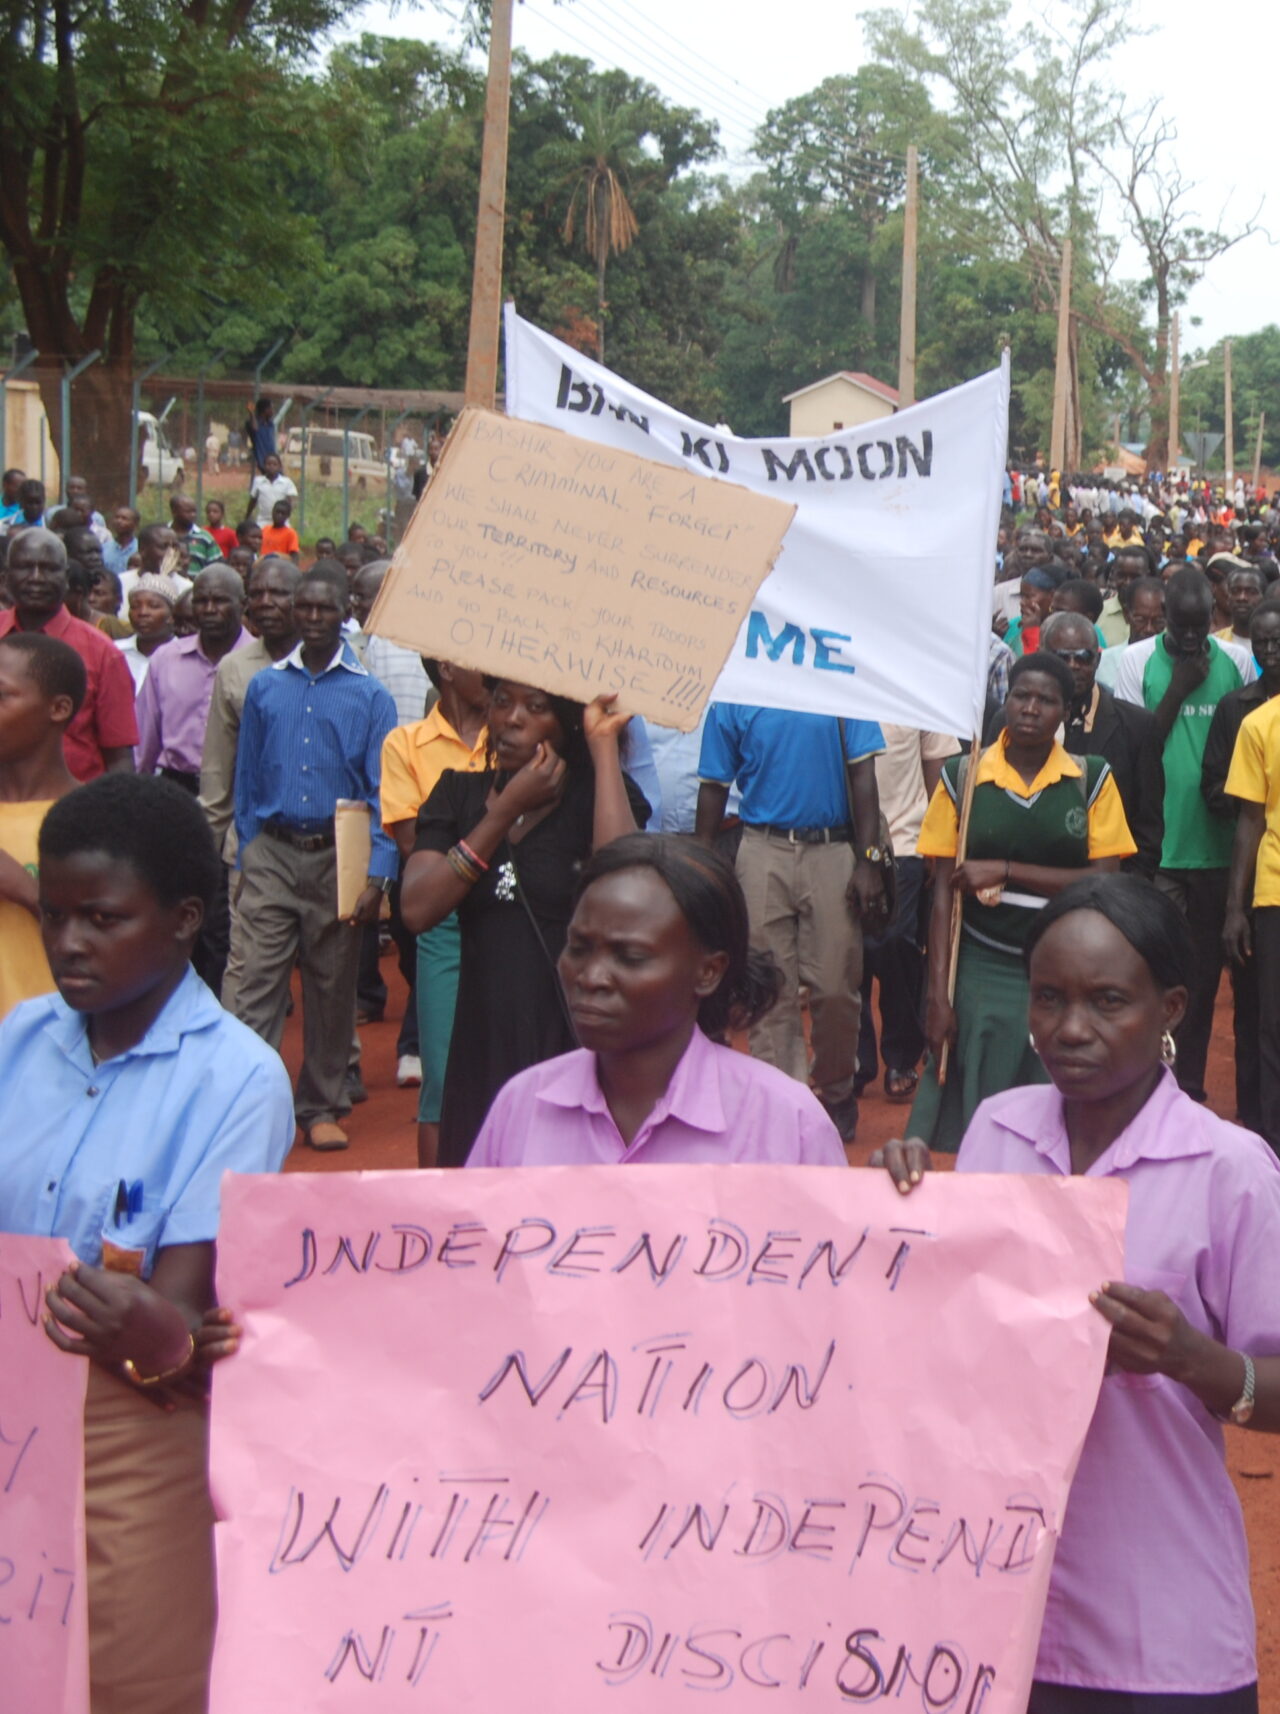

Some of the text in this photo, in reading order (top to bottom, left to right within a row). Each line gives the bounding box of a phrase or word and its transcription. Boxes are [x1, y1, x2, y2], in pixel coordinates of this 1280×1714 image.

[575, 446, 617, 473] YOU
[630, 467, 665, 493] ARE
[679, 485, 696, 506] A
[761, 430, 933, 482] MOON
[445, 482, 477, 501] WE
[553, 518, 625, 555] NEVER
[432, 508, 739, 615] OUR TERRITORY AND RESOURCES
[407, 584, 444, 604] AND
[496, 607, 549, 634] BACK
[596, 634, 704, 681] KHARTOUM
[430, 558, 706, 650] PLEASE PACK YOUR TROOPS
[450, 617, 656, 696] OTHERWISE
